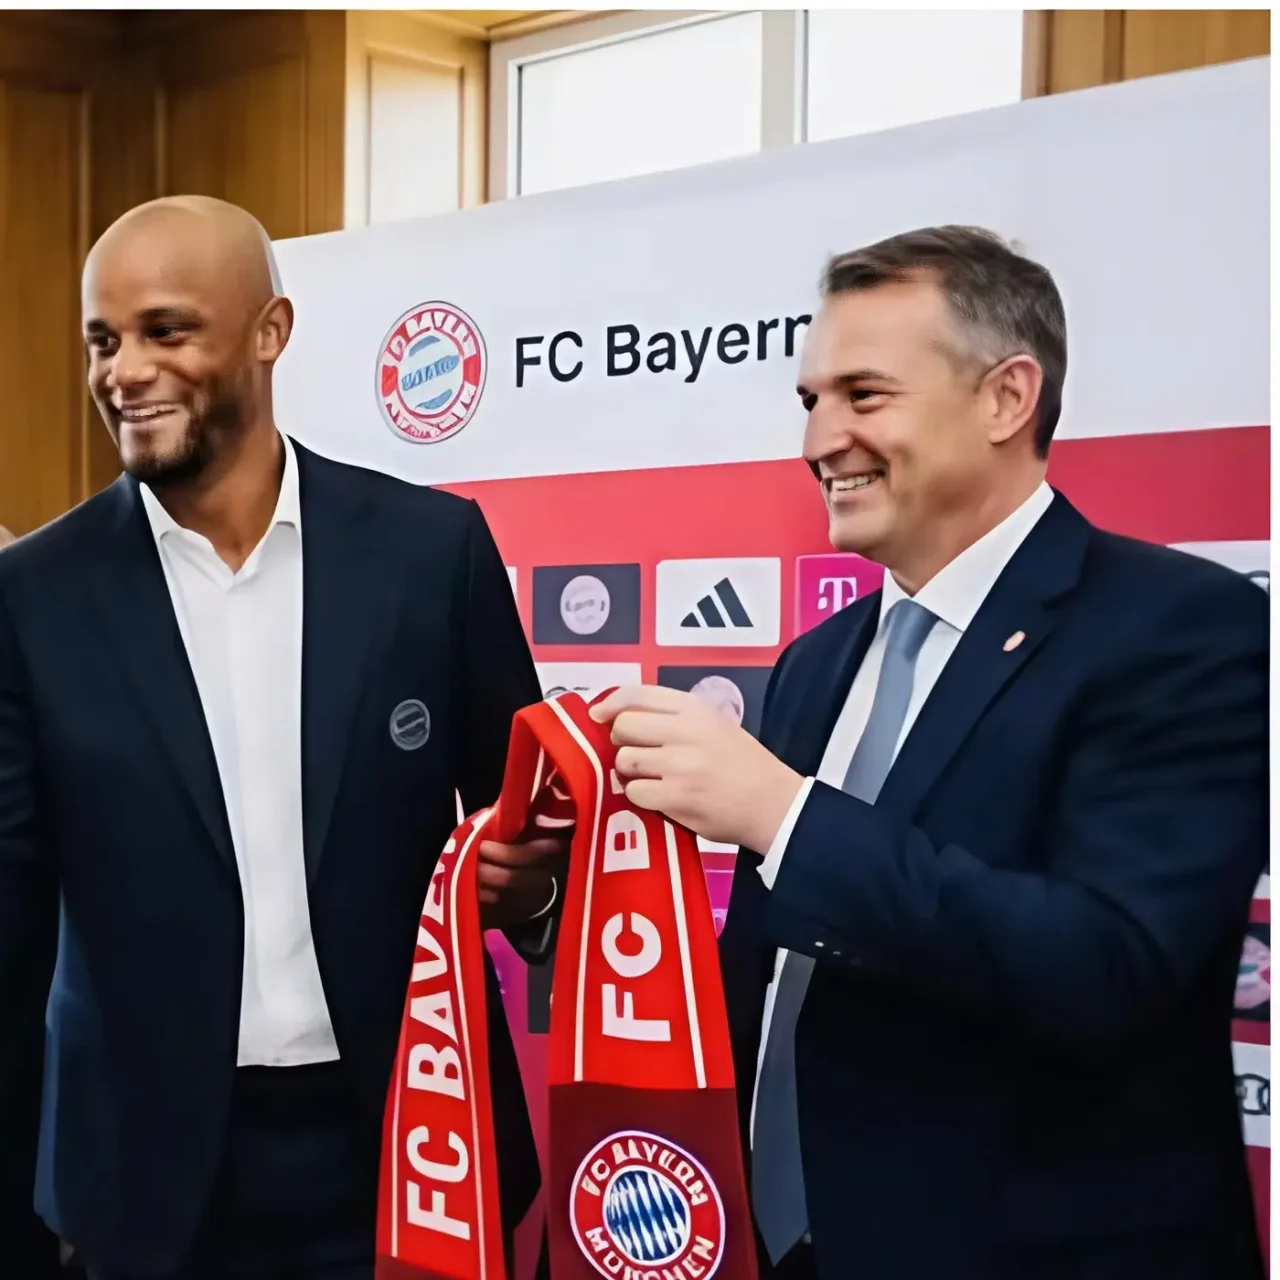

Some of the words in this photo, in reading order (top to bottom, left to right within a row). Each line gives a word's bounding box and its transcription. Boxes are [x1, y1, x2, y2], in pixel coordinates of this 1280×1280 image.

[516, 330, 583, 388] FC
[601, 911, 672, 1042] FC
[406, 1124, 471, 1240] FC
